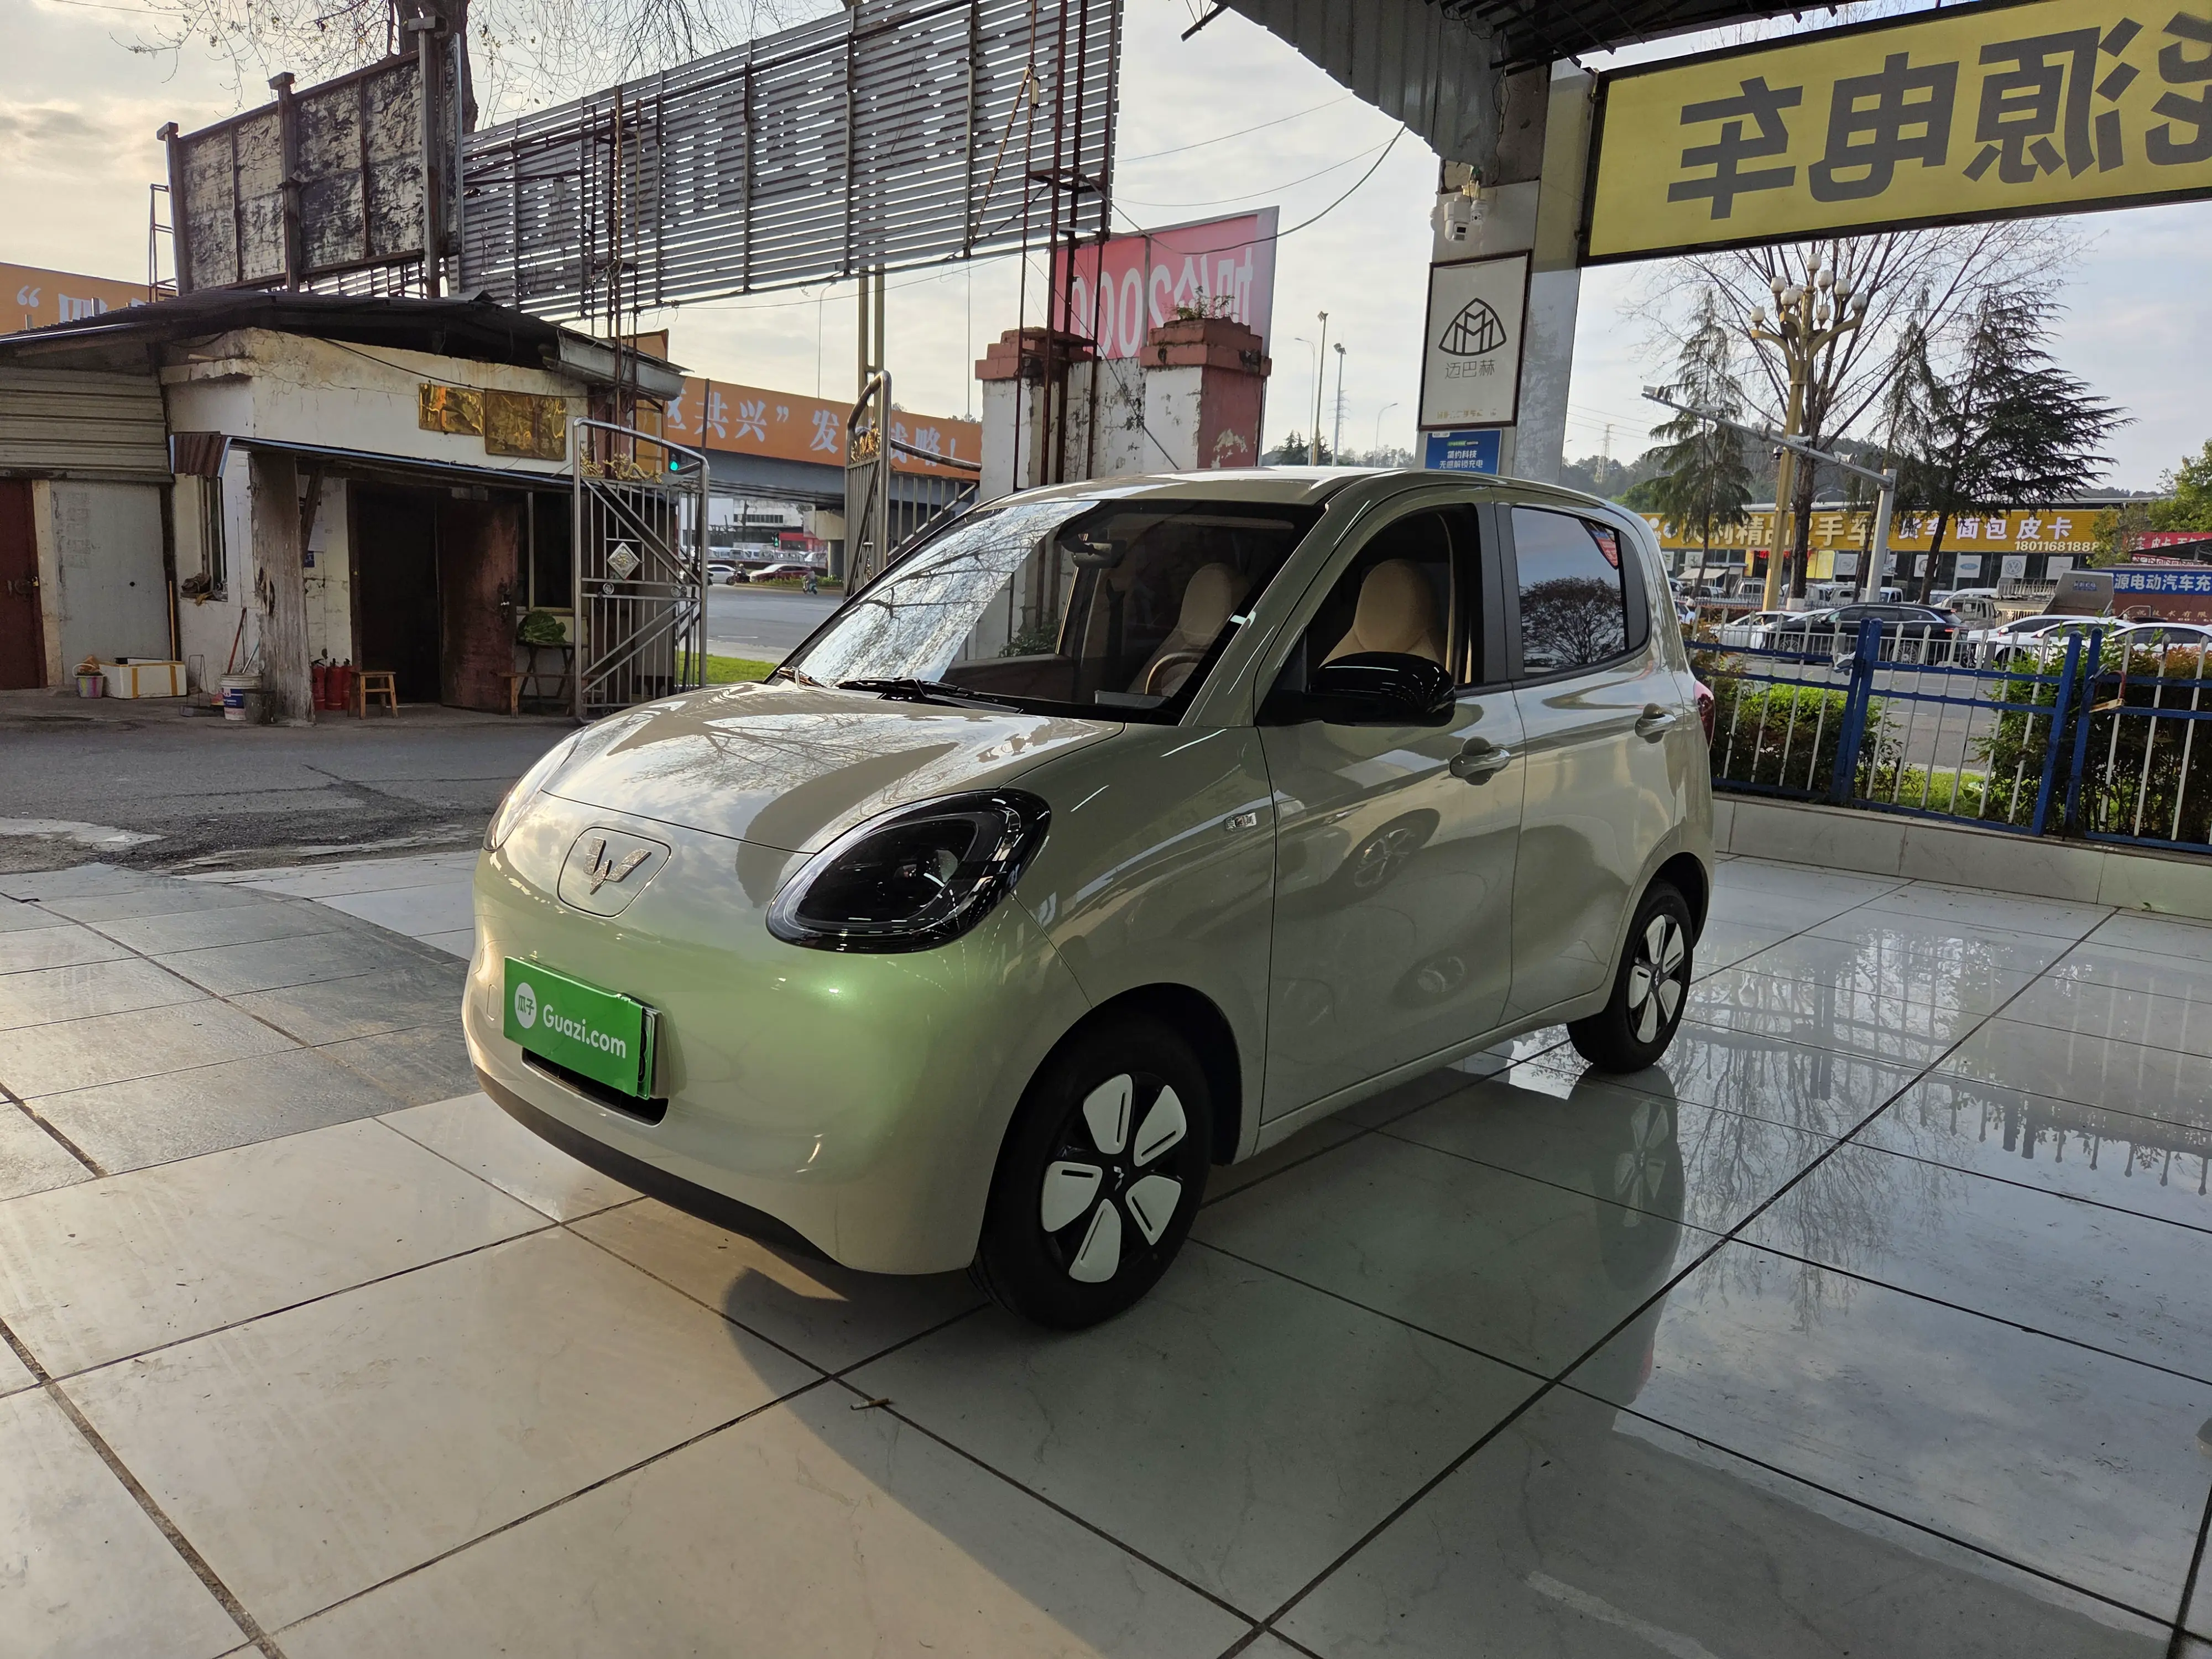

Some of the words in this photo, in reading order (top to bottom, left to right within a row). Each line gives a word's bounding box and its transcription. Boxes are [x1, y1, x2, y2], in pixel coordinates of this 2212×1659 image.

[1444, 359, 1495, 379] 迈巴赫
[1956, 517, 2007, 540] 面包
[2016, 517, 2073, 540] 皮卡
[2114, 573, 2211, 592] 源电动汽车充
[517, 995, 535, 1016] 瓜子
[543, 1004, 626, 1059] Guazi.com
